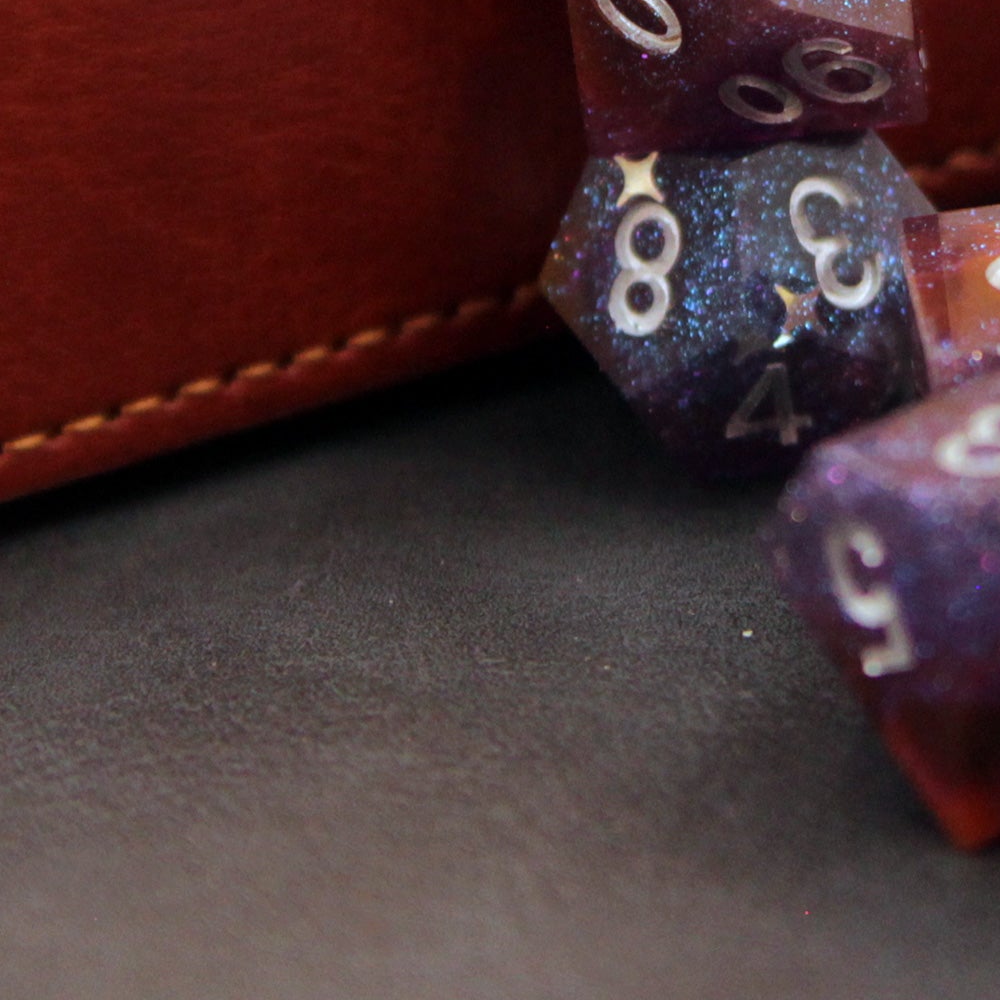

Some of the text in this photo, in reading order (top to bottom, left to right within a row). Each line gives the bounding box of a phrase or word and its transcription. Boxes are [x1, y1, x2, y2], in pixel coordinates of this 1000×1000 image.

[608, 203, 681, 336] 8
[789, 175, 884, 310] 3
[725, 362, 812, 446] 4
[825, 520, 913, 678] 5
